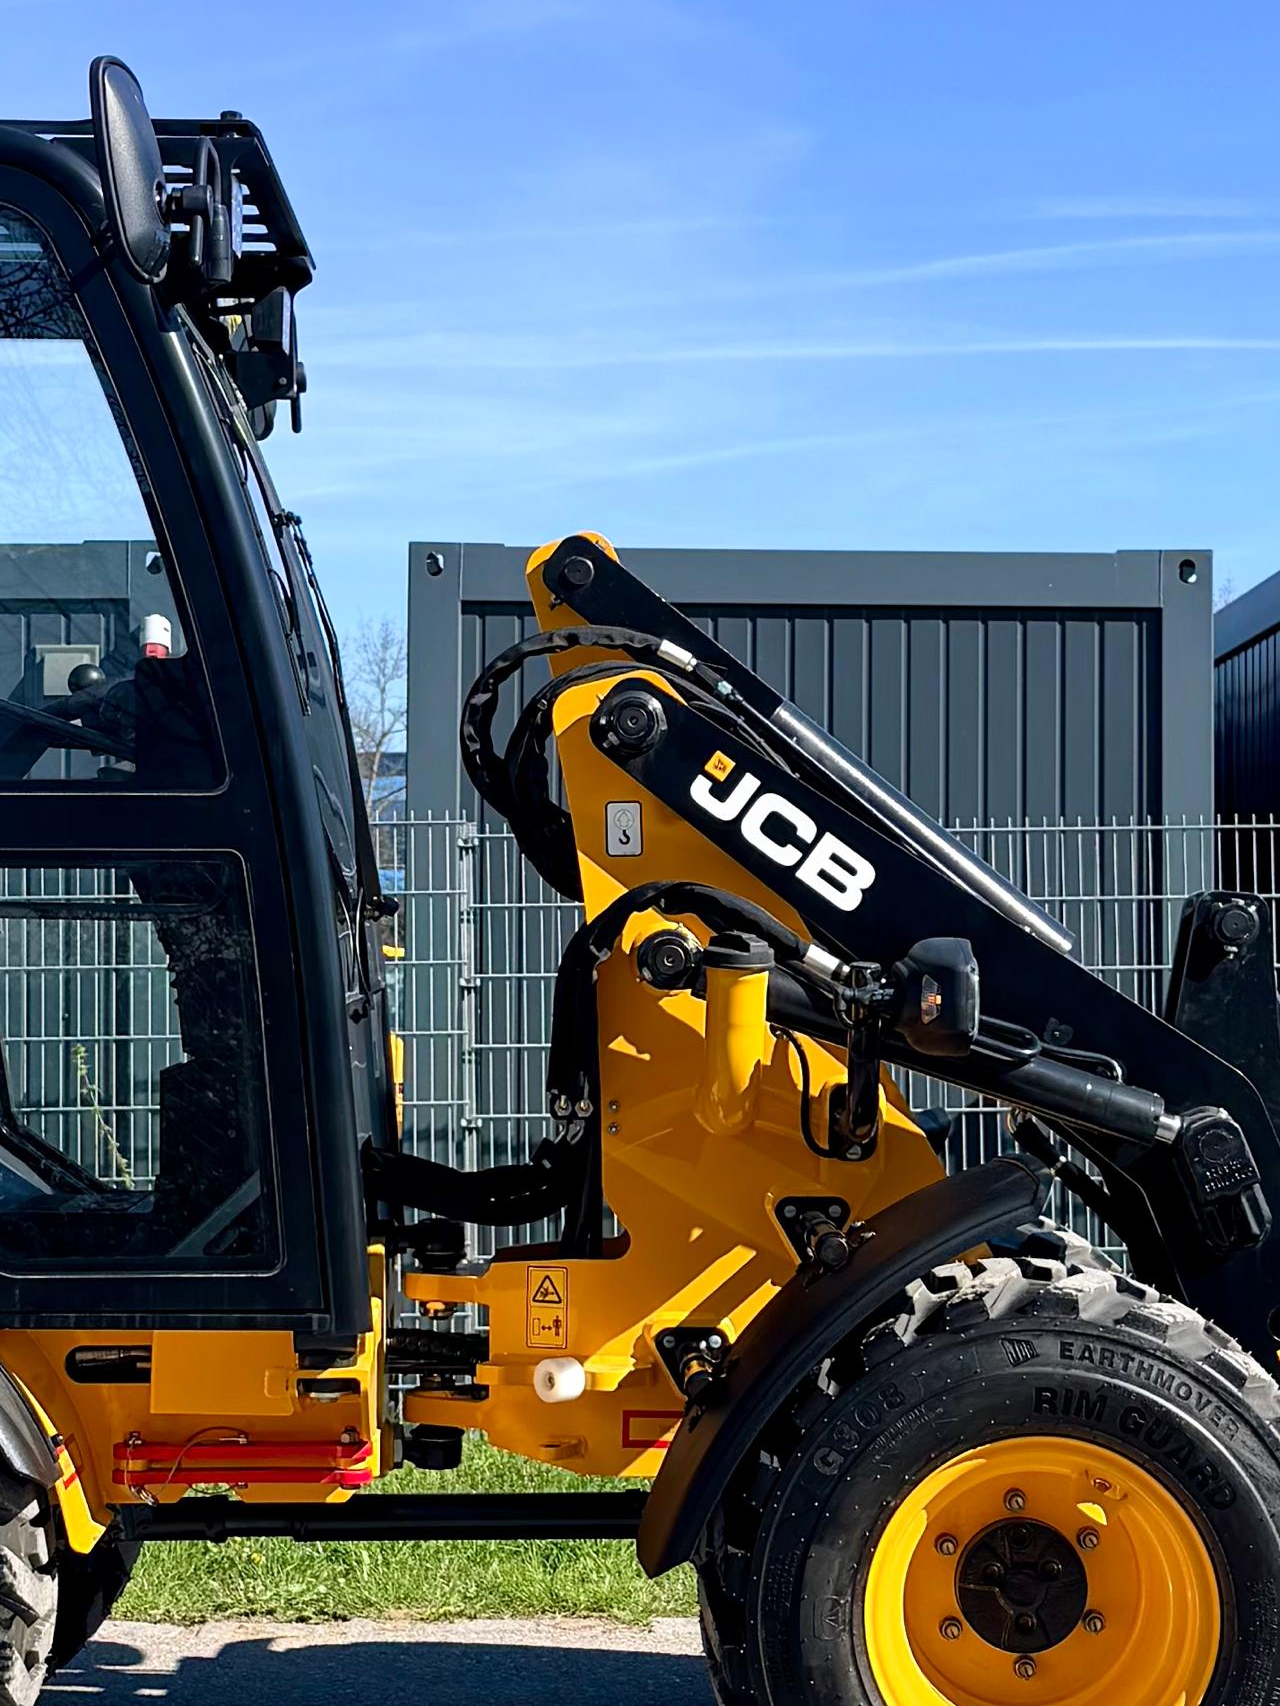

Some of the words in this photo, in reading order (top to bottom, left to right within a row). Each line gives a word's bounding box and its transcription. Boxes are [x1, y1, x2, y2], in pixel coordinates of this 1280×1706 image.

[690, 749, 876, 912] JCB
[1032, 1385, 1109, 1423] RIM
[1118, 1405, 1237, 1511] GUARD
[1058, 1340, 1240, 1442] EARTHMOVER
